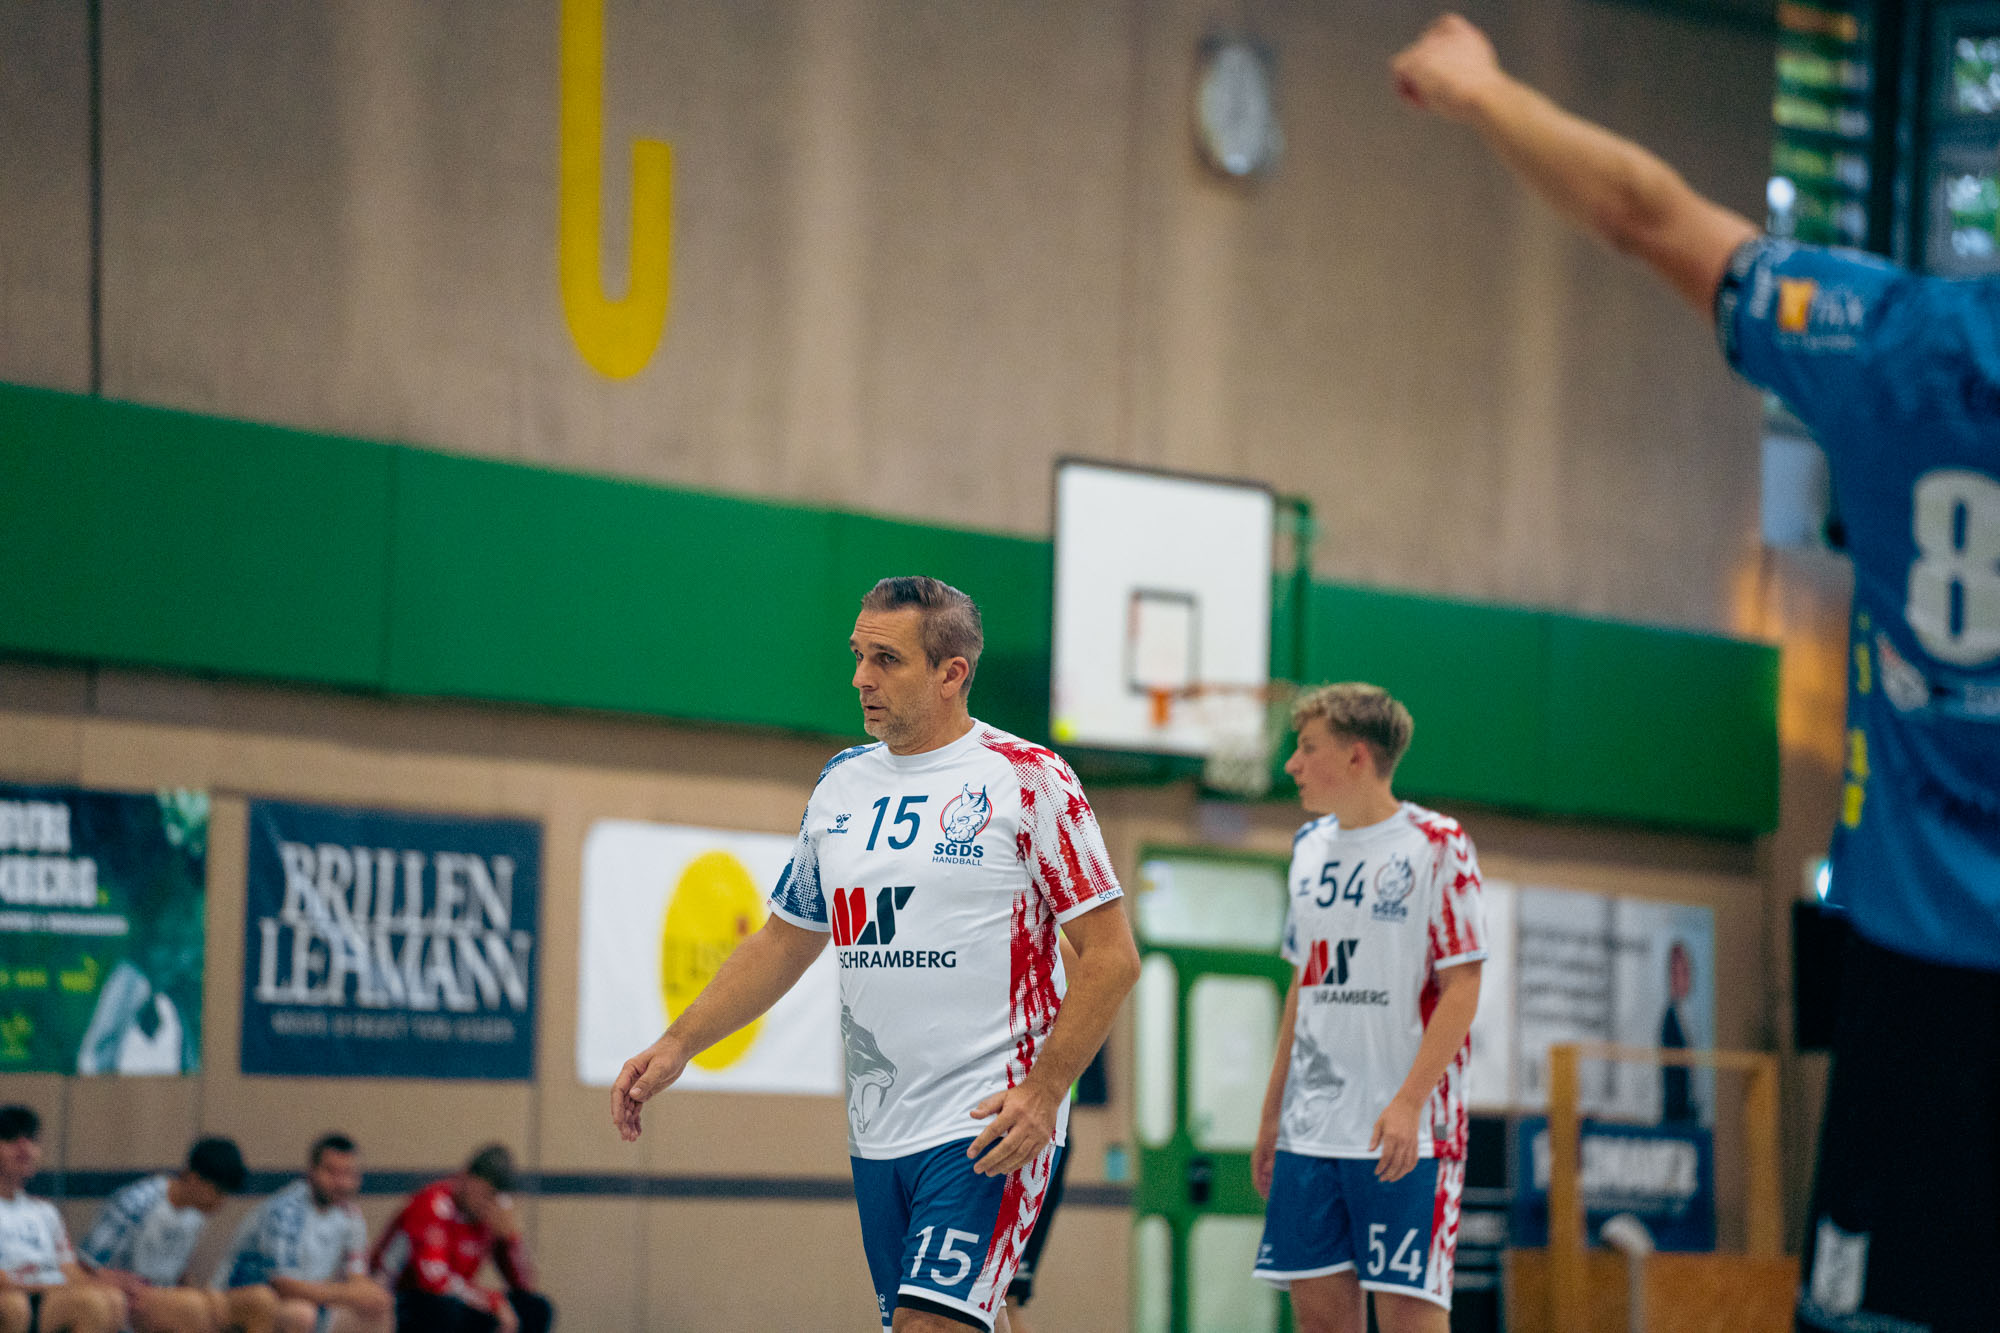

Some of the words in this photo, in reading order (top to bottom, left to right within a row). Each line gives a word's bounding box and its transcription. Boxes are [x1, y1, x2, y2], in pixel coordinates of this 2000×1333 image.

[1904, 468, 2000, 668] 8
[866, 795, 930, 851] 15
[932, 856, 983, 866] HANDBALL
[933, 842, 985, 858] SGDS
[1316, 860, 1366, 908] 54
[839, 950, 957, 969] SCHRAMBERG
[910, 1225, 980, 1287] 15
[1367, 1223, 1422, 1282] 54
